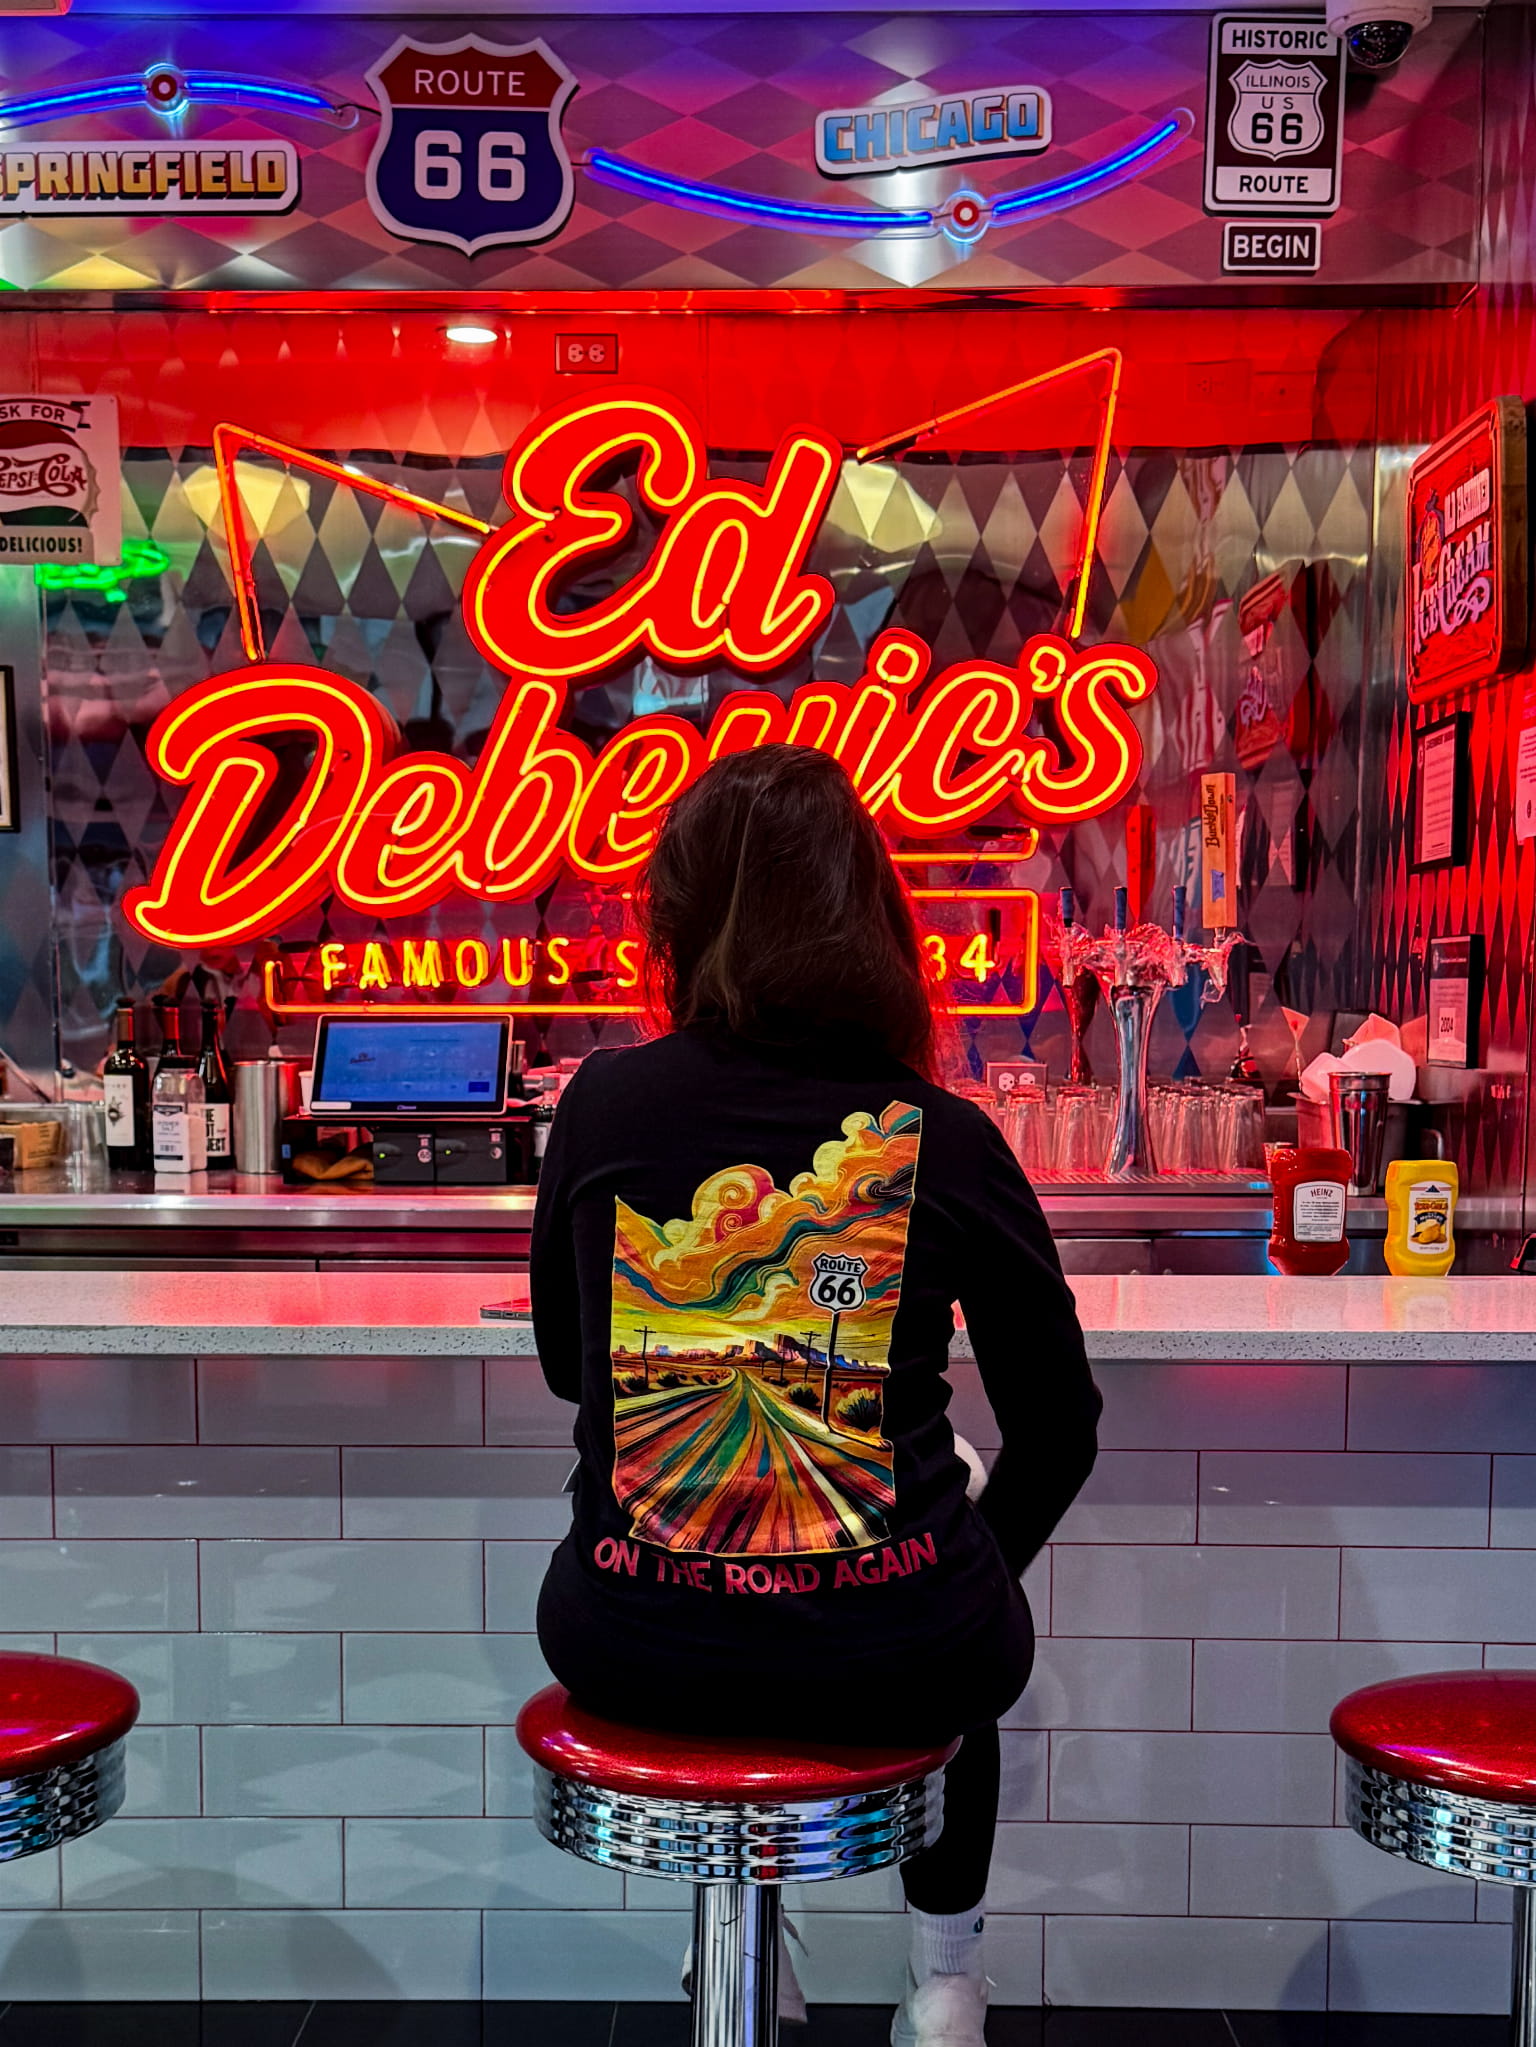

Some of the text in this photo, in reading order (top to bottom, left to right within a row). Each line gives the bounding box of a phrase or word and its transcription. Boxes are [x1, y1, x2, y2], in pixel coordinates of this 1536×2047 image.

[1231, 29, 1328, 50] HISTORIC
[414, 68, 527, 97] ROUTE
[1245, 73, 1311, 90] ILLINOIS
[822, 92, 1046, 164] CHICAGO
[1250, 111, 1303, 146] 66
[0, 150, 289, 201] PRINGFIELD
[413, 129, 526, 202] 66
[1238, 174, 1309, 196] ROUTE
[1233, 233, 1311, 260] BEGIN
[0, 404, 66, 423] SK FOR
[464, 388, 840, 672] Ed
[320, 937, 571, 992] FAMOUS
[1310, 1187, 1335, 1198] HEINZ
[819, 1257, 862, 1274] ROUTE
[817, 1274, 857, 1306] 66
[593, 1532, 939, 1595] ON THE ROAD AGAIN
